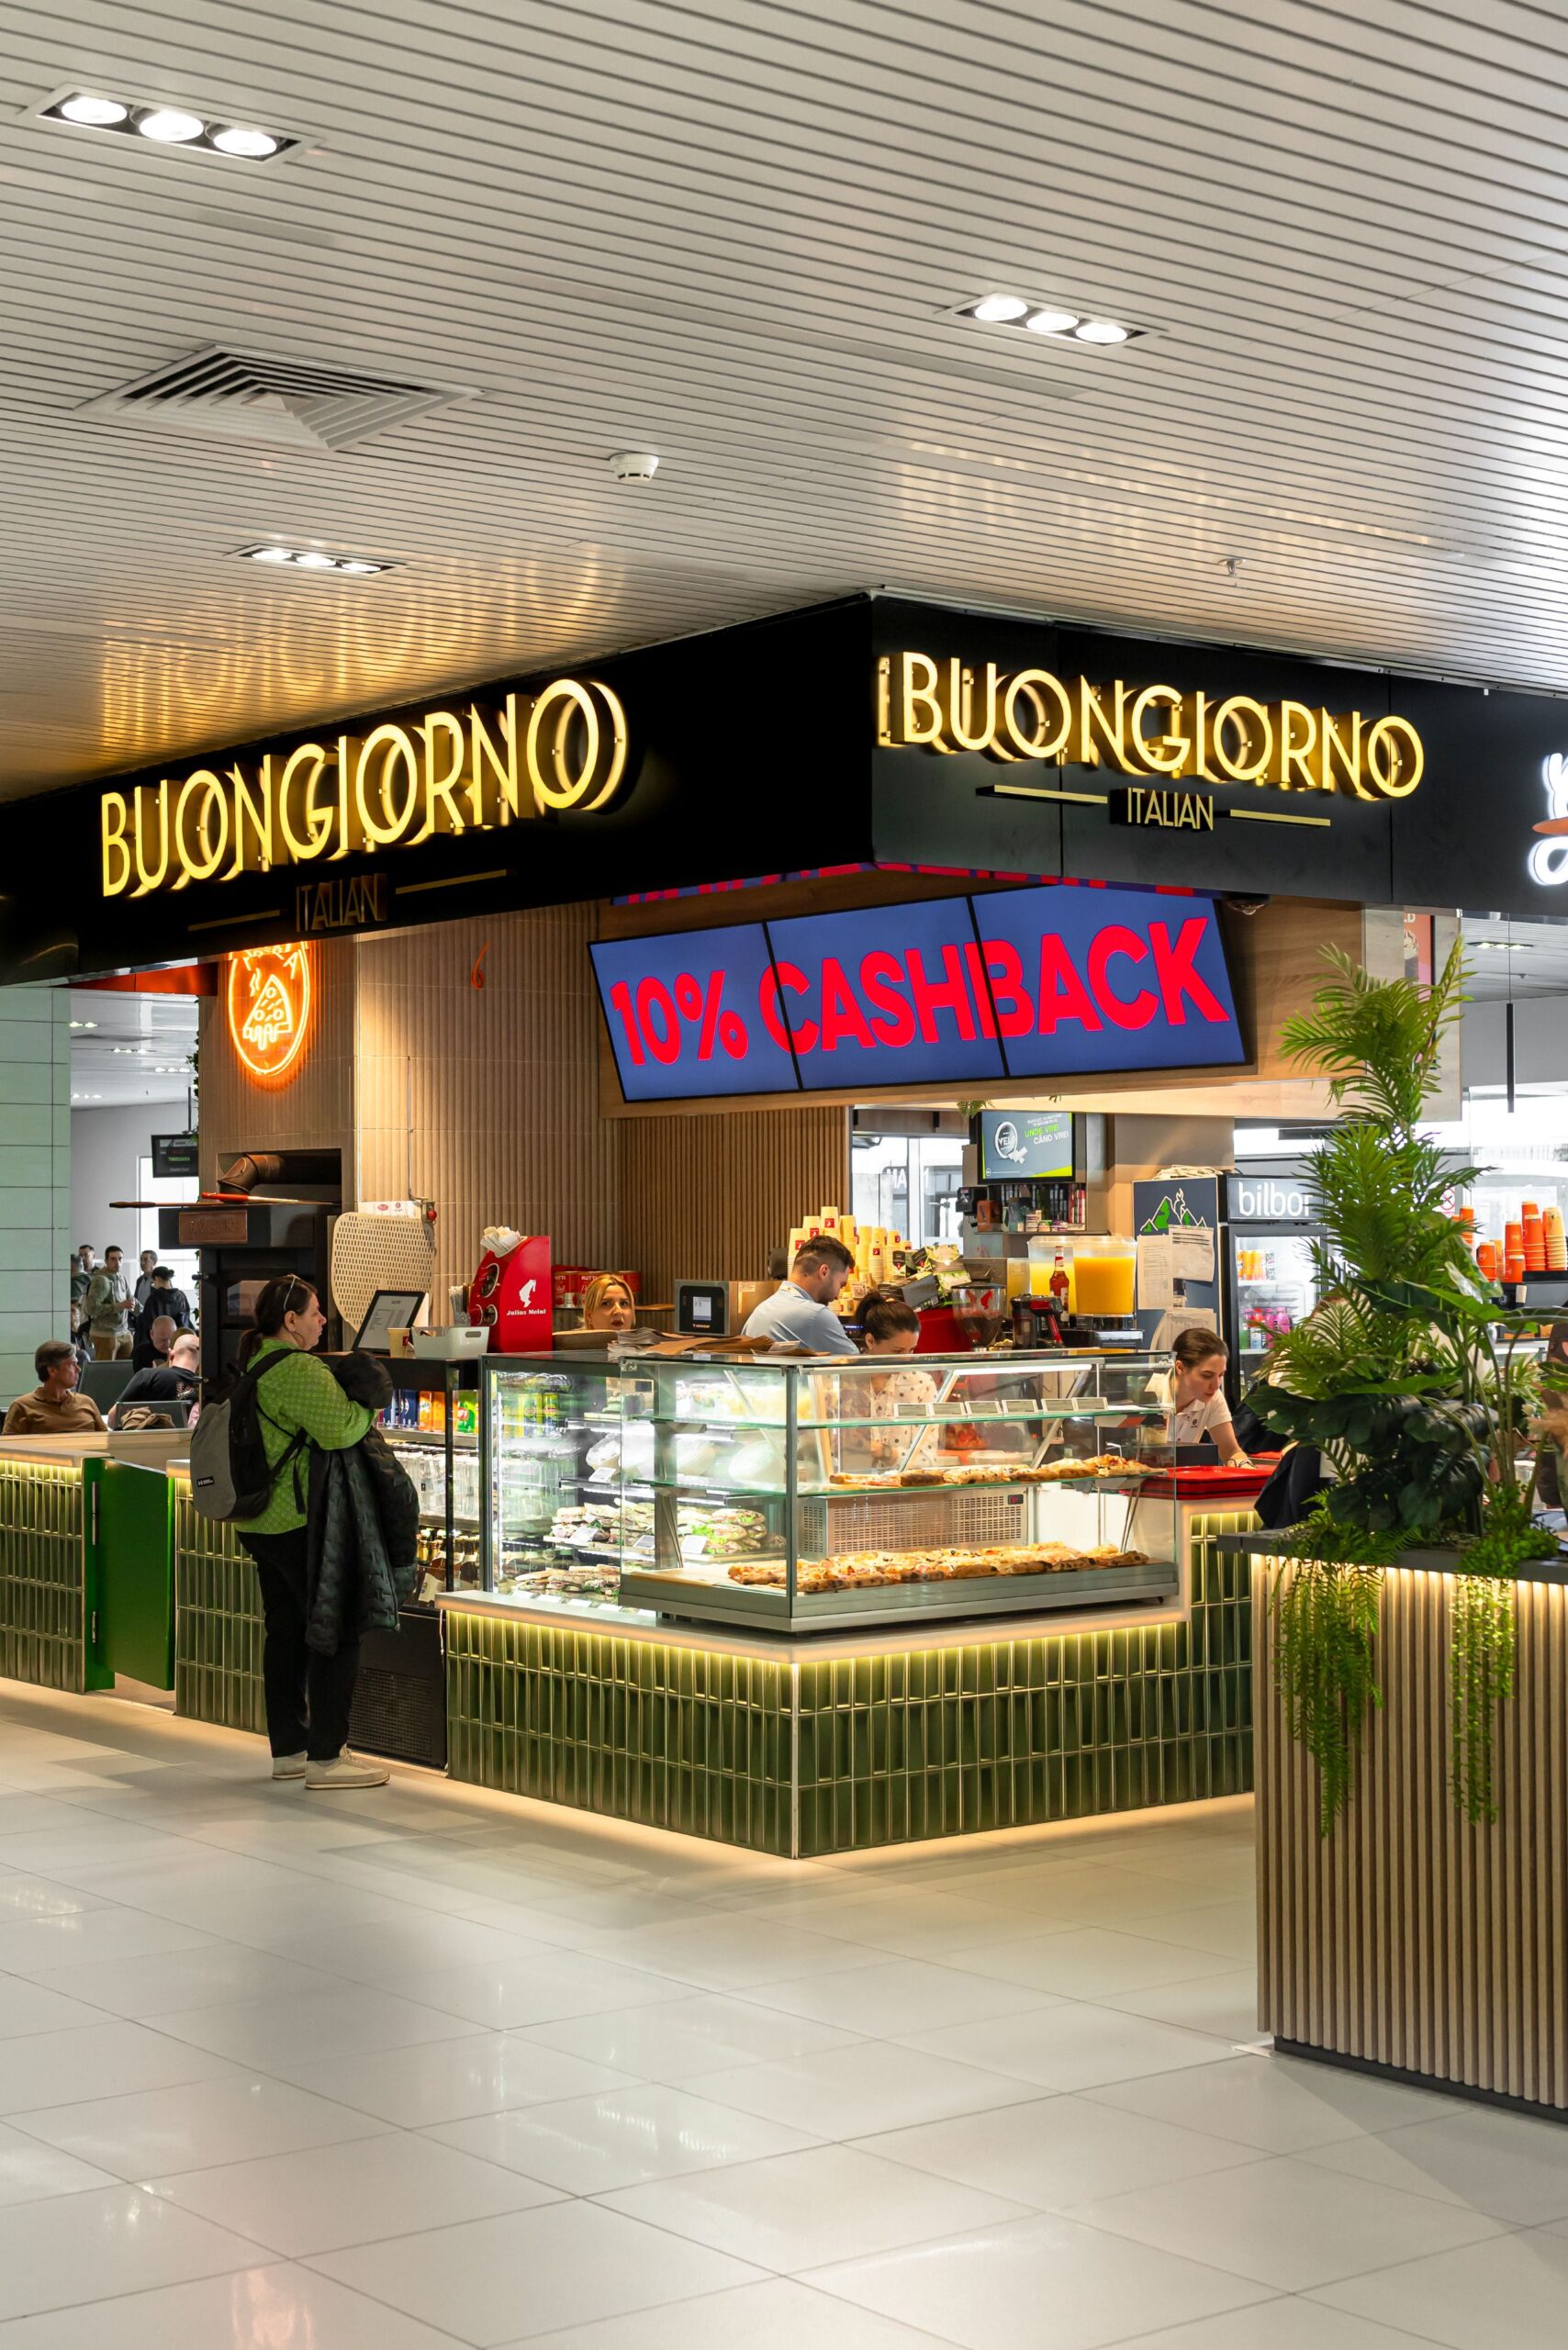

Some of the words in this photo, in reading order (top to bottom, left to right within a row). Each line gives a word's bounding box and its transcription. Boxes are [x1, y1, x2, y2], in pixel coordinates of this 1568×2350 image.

[879, 652, 1425, 800] BUONGIORNO
[102, 679, 628, 898] BUONGIORNO
[1126, 787, 1214, 832] ITALIAN
[296, 874, 385, 933] ITALIAN
[610, 970, 749, 1066] 10%
[758, 917, 1229, 1055] CASHBACK
[1238, 1181, 1313, 1217] bilbor
